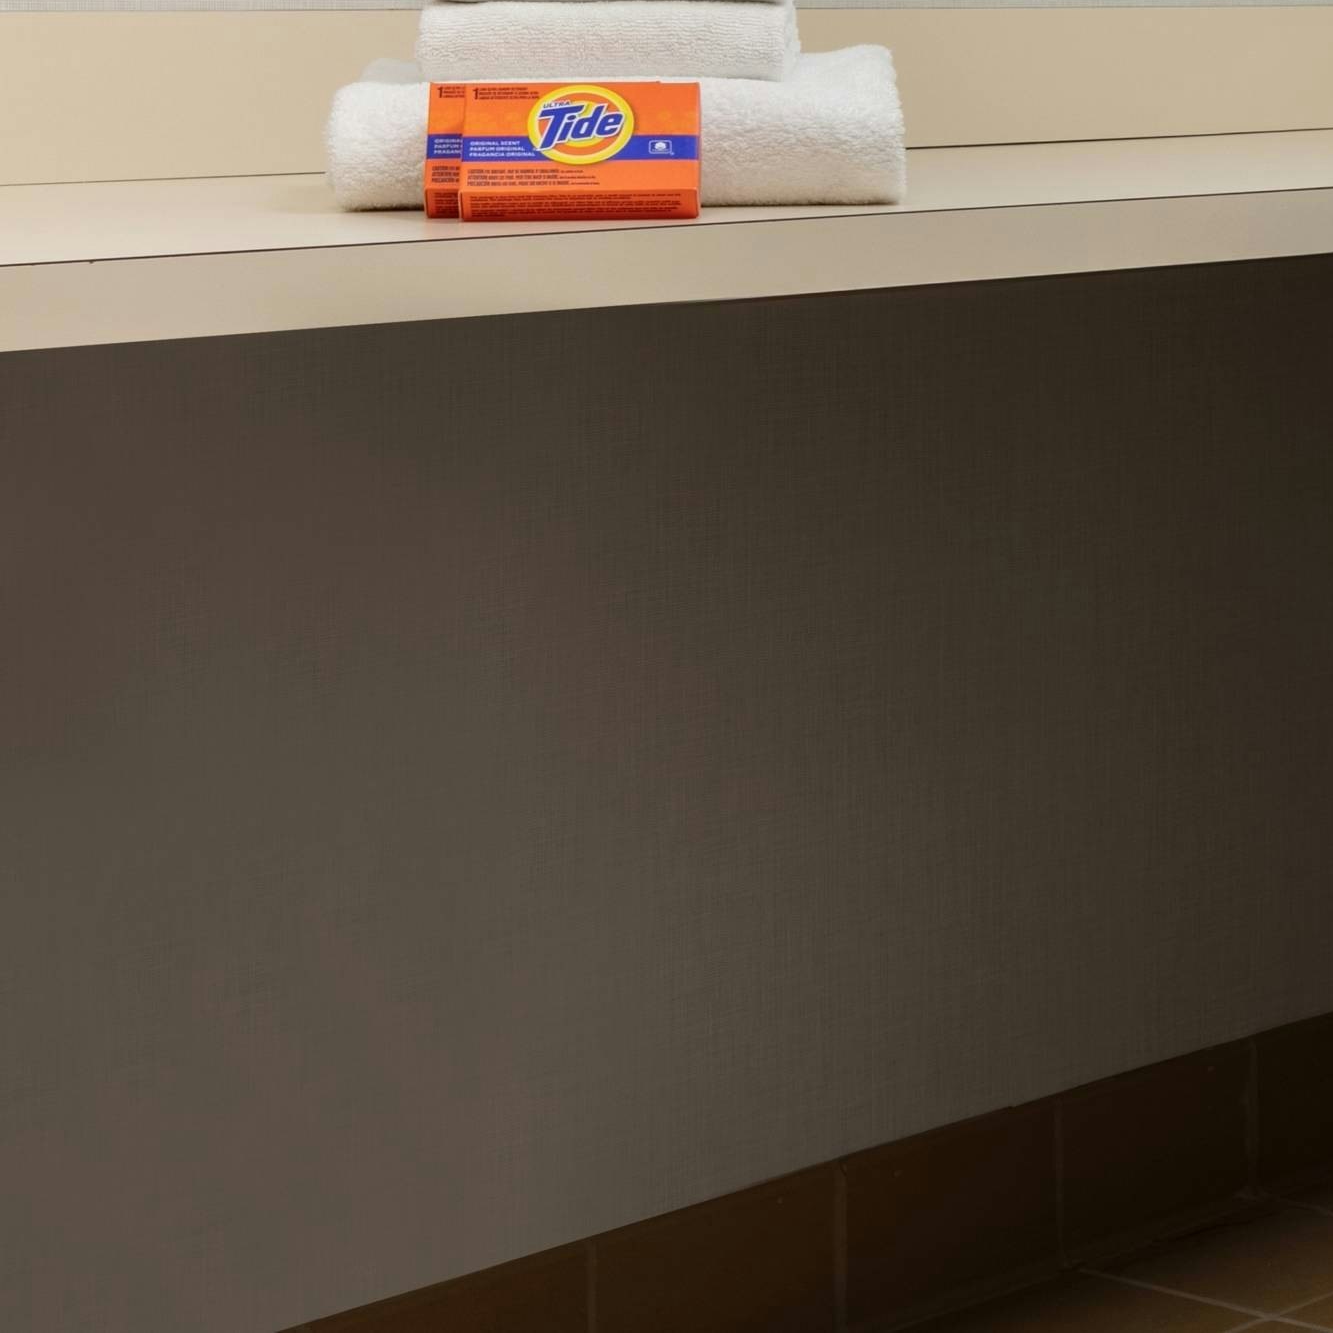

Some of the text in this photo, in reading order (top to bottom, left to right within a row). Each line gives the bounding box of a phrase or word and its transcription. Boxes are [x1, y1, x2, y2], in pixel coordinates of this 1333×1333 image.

[437, 86, 443, 98] 1
[472, 88, 479, 100] 1
[543, 100, 571, 109] ULTRA
[537, 103, 625, 151] Tide
